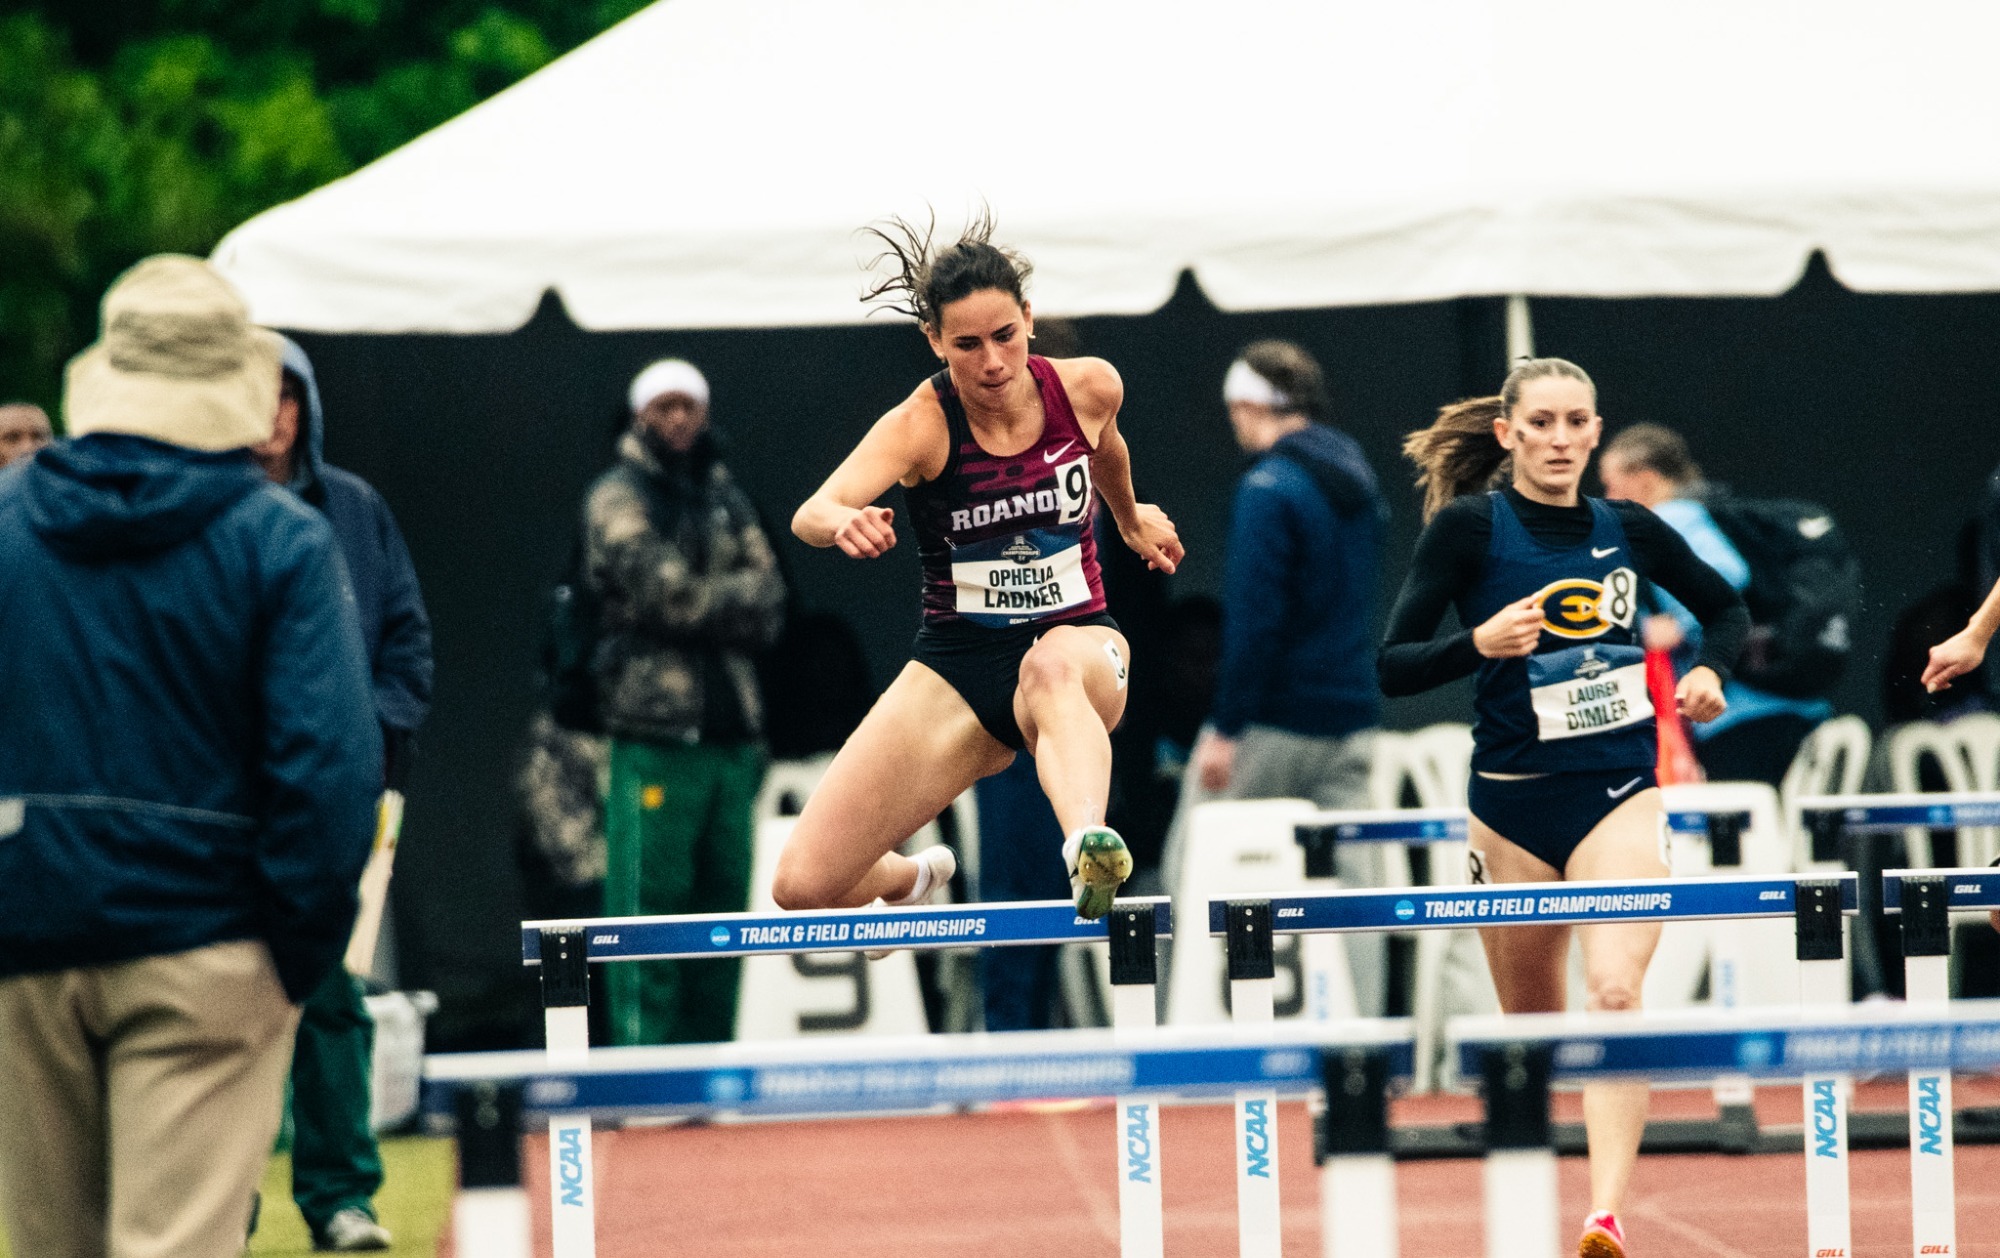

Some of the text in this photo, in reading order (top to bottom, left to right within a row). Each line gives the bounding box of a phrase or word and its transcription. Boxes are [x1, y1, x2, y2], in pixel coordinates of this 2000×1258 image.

[1065, 464, 1087, 519] 9
[951, 488, 1060, 531] ROANO
[989, 565, 1054, 587] OPHELIA
[984, 582, 1064, 608] LADNER
[1611, 571, 1629, 620] 8
[1567, 681, 1619, 705] LAUREN
[1565, 699, 1630, 730] DIMLER
[1759, 890, 1787, 900] GILL
[1953, 884, 1982, 894] GILL
[1277, 907, 1305, 918] GILL
[1425, 893, 1672, 918] TRACK & FIELD CHAMPIONSHIPS
[592, 934, 620, 945] GILL
[740, 918, 987, 945] TRACK & FIELD CHAMPIONSHIPS
[1813, 1080, 1838, 1159] NCAA
[1918, 1076, 1943, 1156] NCAA
[1127, 1104, 1152, 1184] NCAA
[1245, 1099, 1270, 1179] NCAA
[559, 1128, 584, 1207] NCAA
[1816, 1248, 1845, 1257] GILL
[1920, 1245, 1949, 1254] GILL
